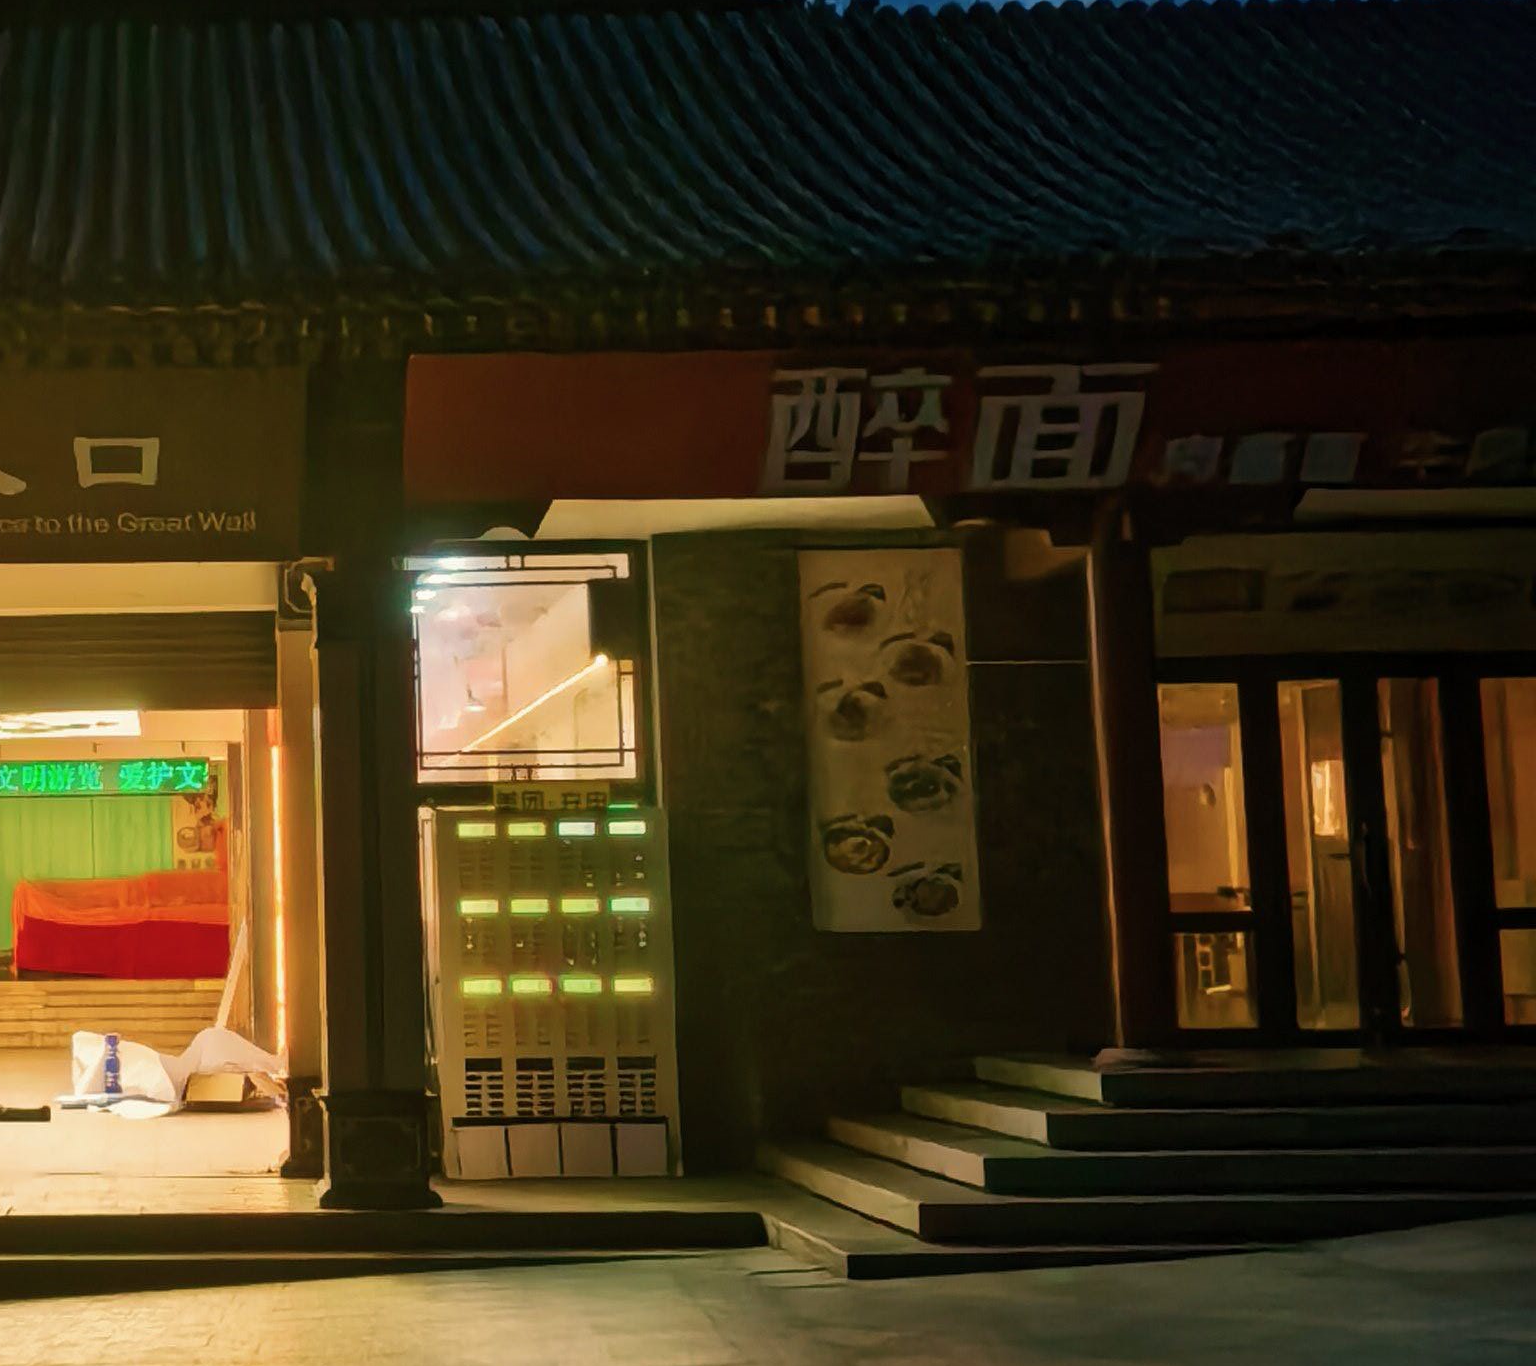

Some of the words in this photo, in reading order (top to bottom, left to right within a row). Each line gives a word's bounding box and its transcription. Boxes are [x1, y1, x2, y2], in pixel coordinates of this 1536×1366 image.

[758, 363, 1160, 493] 醉面
[34, 514, 61, 534] to
[66, 512, 111, 533] the
[117, 511, 193, 533] Great
[196, 509, 257, 532] Wall
